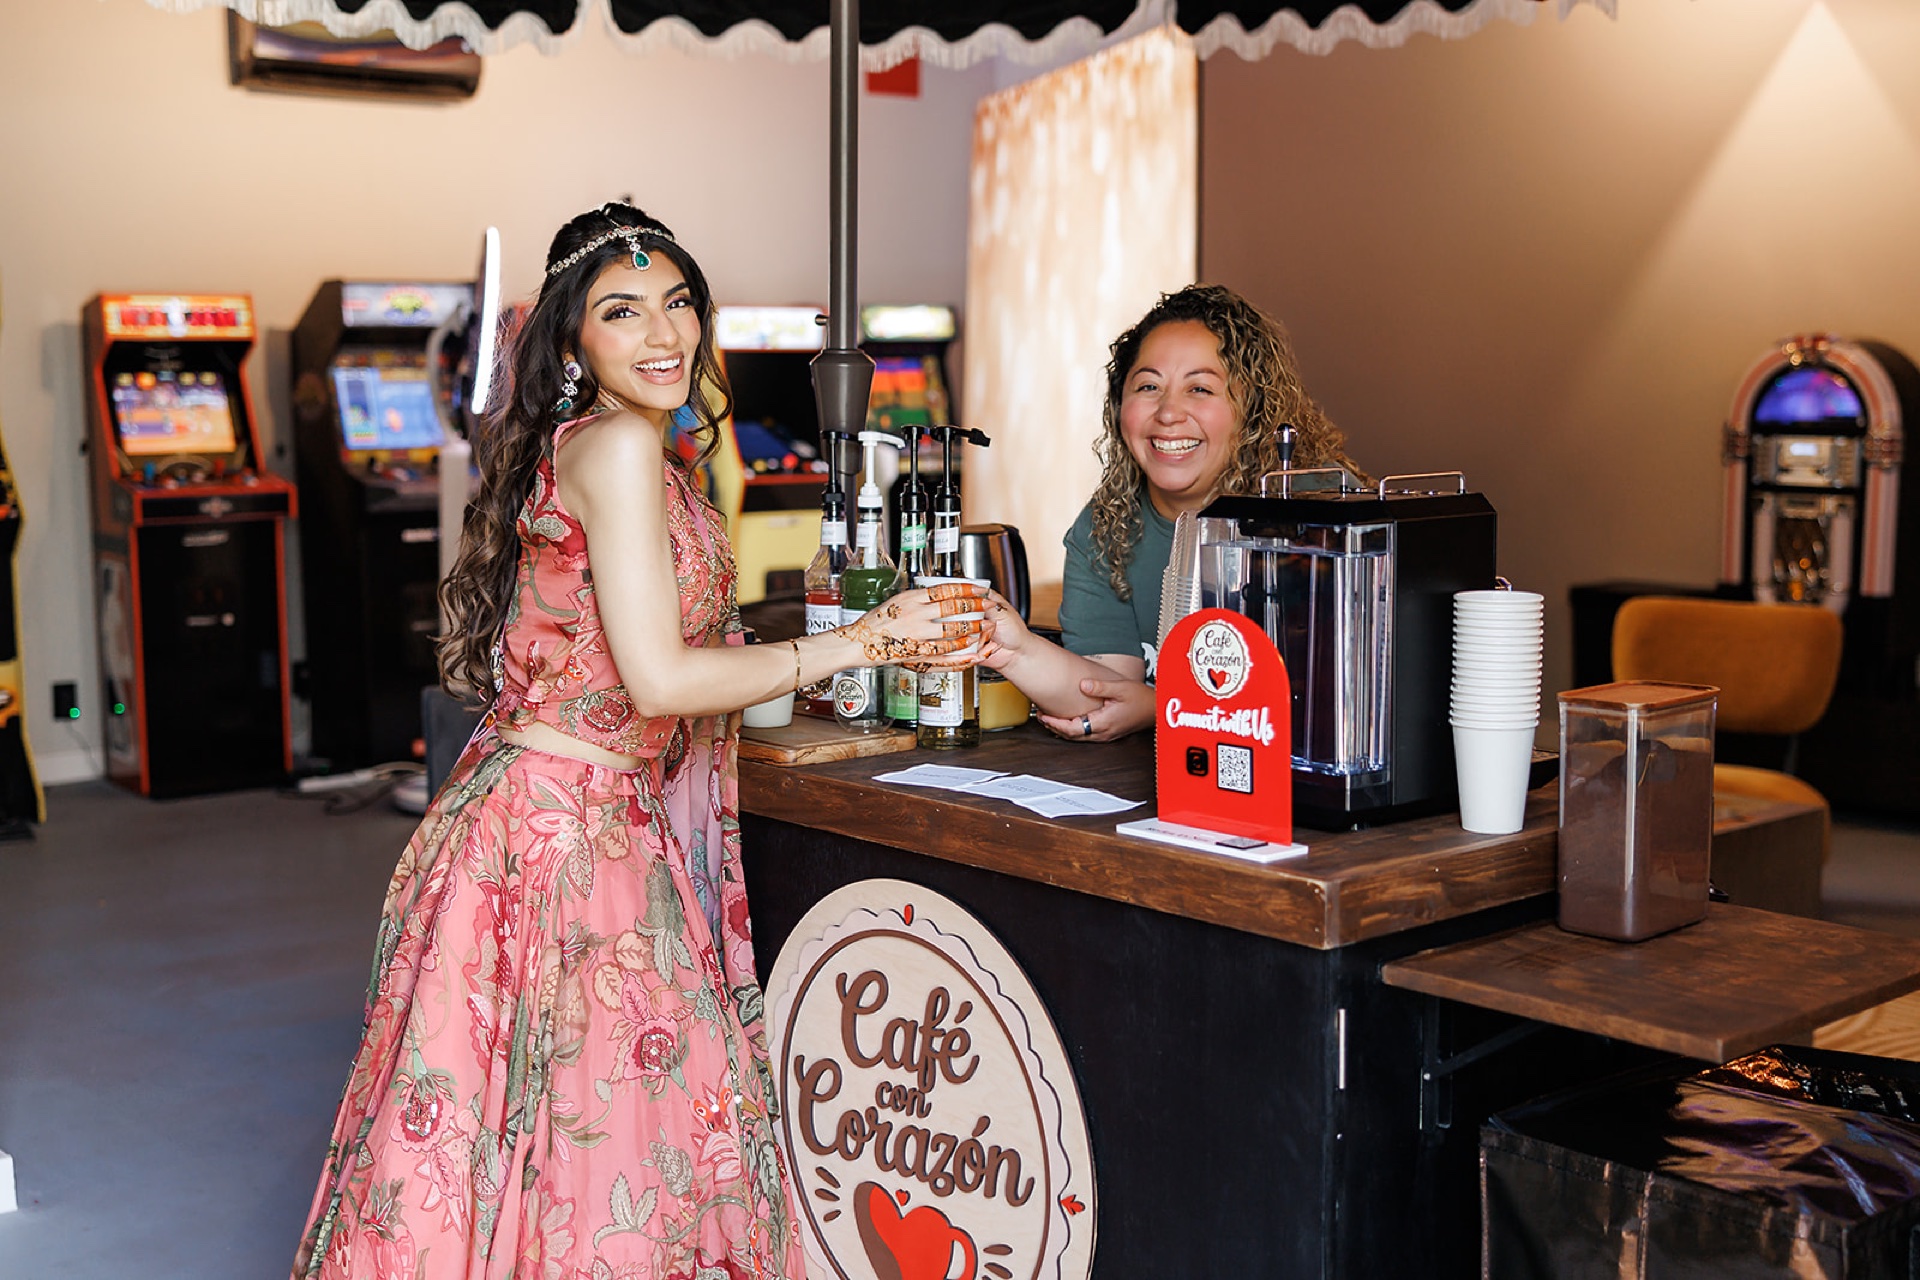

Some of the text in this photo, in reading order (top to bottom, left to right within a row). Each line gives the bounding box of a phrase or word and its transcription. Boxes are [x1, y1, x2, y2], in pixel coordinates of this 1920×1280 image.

[806, 618, 837, 630] ONIN
[1204, 629, 1232, 650] Café
[1194, 647, 1242, 668] Corazón
[1219, 708, 1253, 737] with
[1252, 706, 1275, 746] Us
[836, 970, 980, 1093] Café
[875, 1080, 932, 1119] con
[794, 1054, 1035, 1207] Corazón
